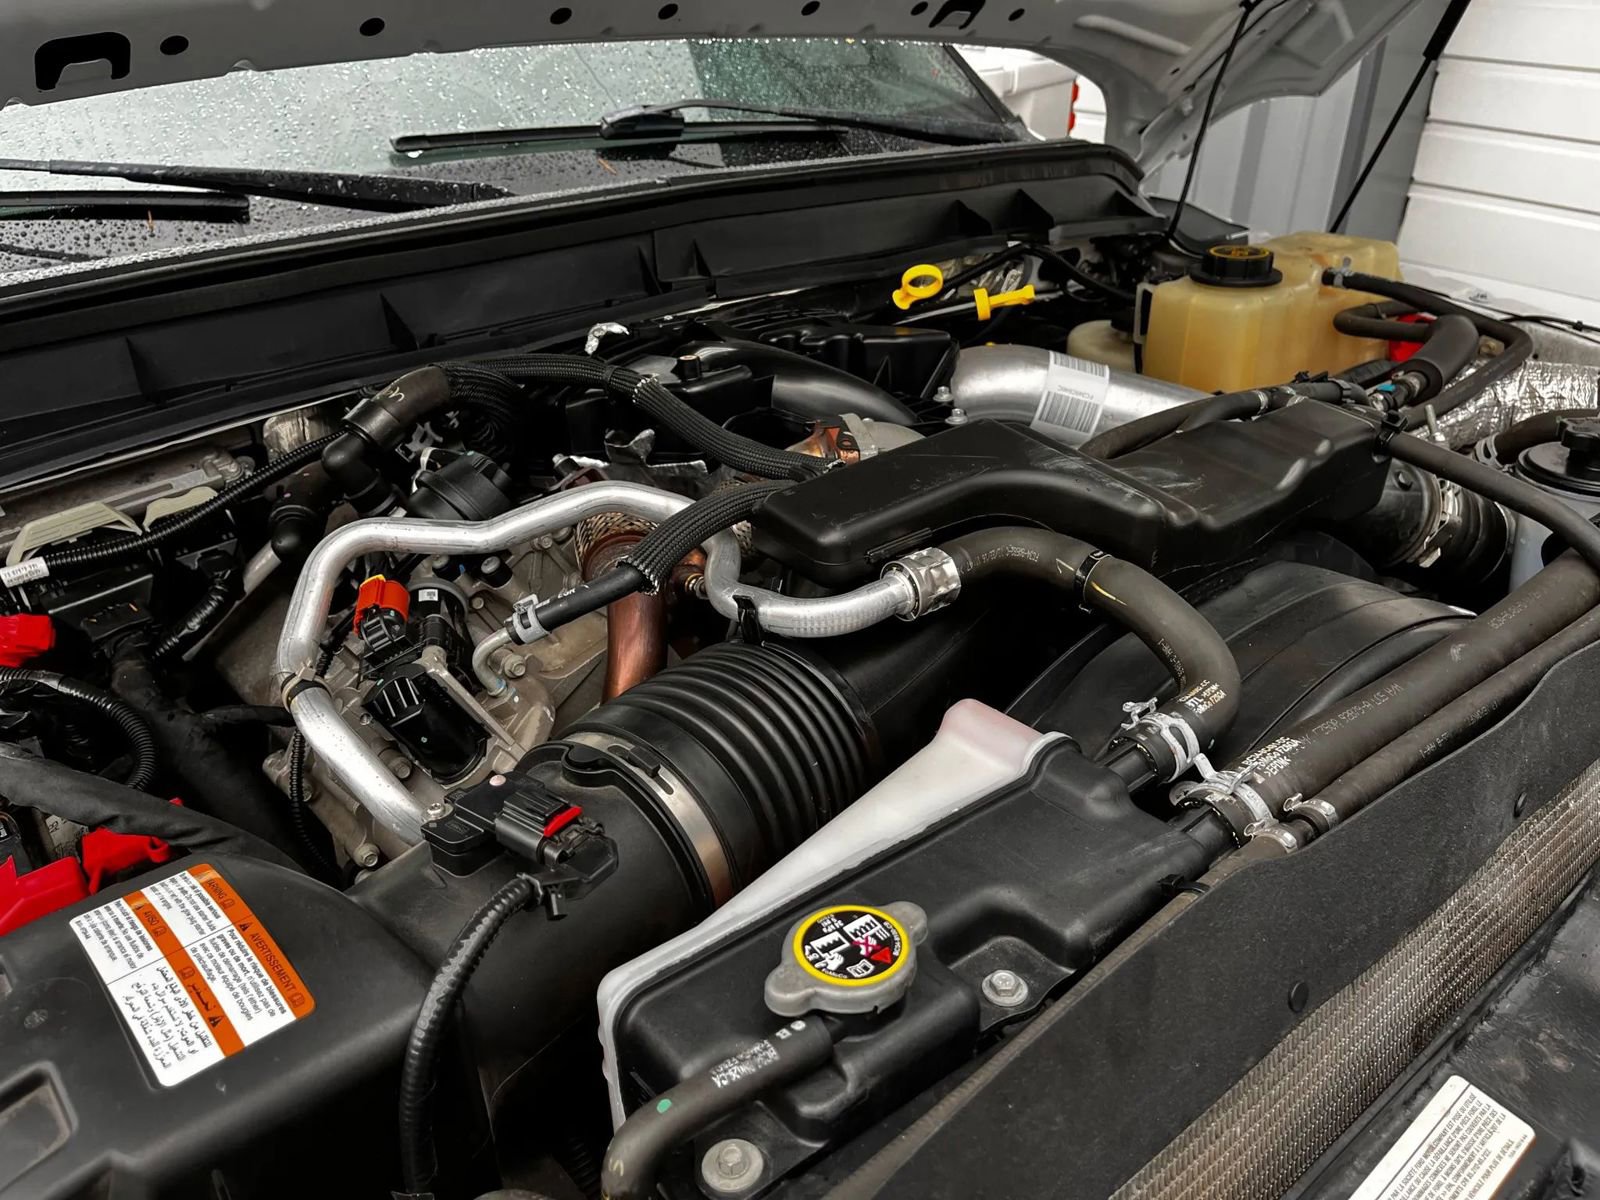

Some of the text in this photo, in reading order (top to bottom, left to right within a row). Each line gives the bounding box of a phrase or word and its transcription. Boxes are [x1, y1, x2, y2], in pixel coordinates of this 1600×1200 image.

[144, 910, 160, 926] AVISO
[129, 940, 140, 953] fluidos
[139, 934, 152, 951] lesiones
[127, 958, 136, 968] motor
[193, 953, 216, 982] préchauffage.
[209, 938, 221, 952] fluides
[223, 958, 242, 983] démarrage
[238, 983, 250, 994] (tels
[250, 932, 297, 992] AVERTISSEMENT
[156, 967, 173, 982] المحتمل
[216, 934, 231, 949] graves
[238, 962, 250, 976] mort,
[247, 976, 264, 998] n'utilisez
[260, 998, 270, 1008] pas
[227, 929, 238, 940] Pour
[235, 940, 249, 957] réduire
[250, 962, 264, 978] risque
[266, 986, 286, 1014] blessures
[200, 943, 210, 953] avec
[211, 959, 224, 974] moteur
[222, 975, 236, 992] équipé
[236, 998, 253, 1020] bougies
[155, 991, 166, 1004] سوائل
[162, 1005, 179, 1021] تستخدم
[182, 1010, 195, 1020] خطر
[189, 1022, 198, 1030] من
[195, 1031, 212, 1048] للتقليل
[168, 1043, 186, 1061] التشغيل
[1489, 1109, 1498, 1118] DES
[1448, 1140, 1462, 1156] SERONT
[1459, 1133, 1468, 1142] PAS
[1465, 1116, 1482, 1135] COUVERTS
[1479, 1108, 1487, 1117] PAR
[1397, 1184, 1404, 1192] LA
[1402, 1168, 1417, 1186] SOCIÉTÉ
[1414, 1158, 1425, 1170] FORD
[1432, 1128, 1449, 1148] COMPANY
[1446, 1120, 1454, 1130] EST
[1452, 1111, 1462, 1123] POSÉ
[1459, 1106, 1466, 1114] OU
[1464, 1093, 1476, 1108] UTILISÉ
[1419, 1165, 1431, 1179] CAUSE
[1433, 1136, 1454, 1161] DÉFAILLANCE
[1481, 1169, 1492, 1181] POUR
[1489, 1159, 1499, 1171] PLUS
